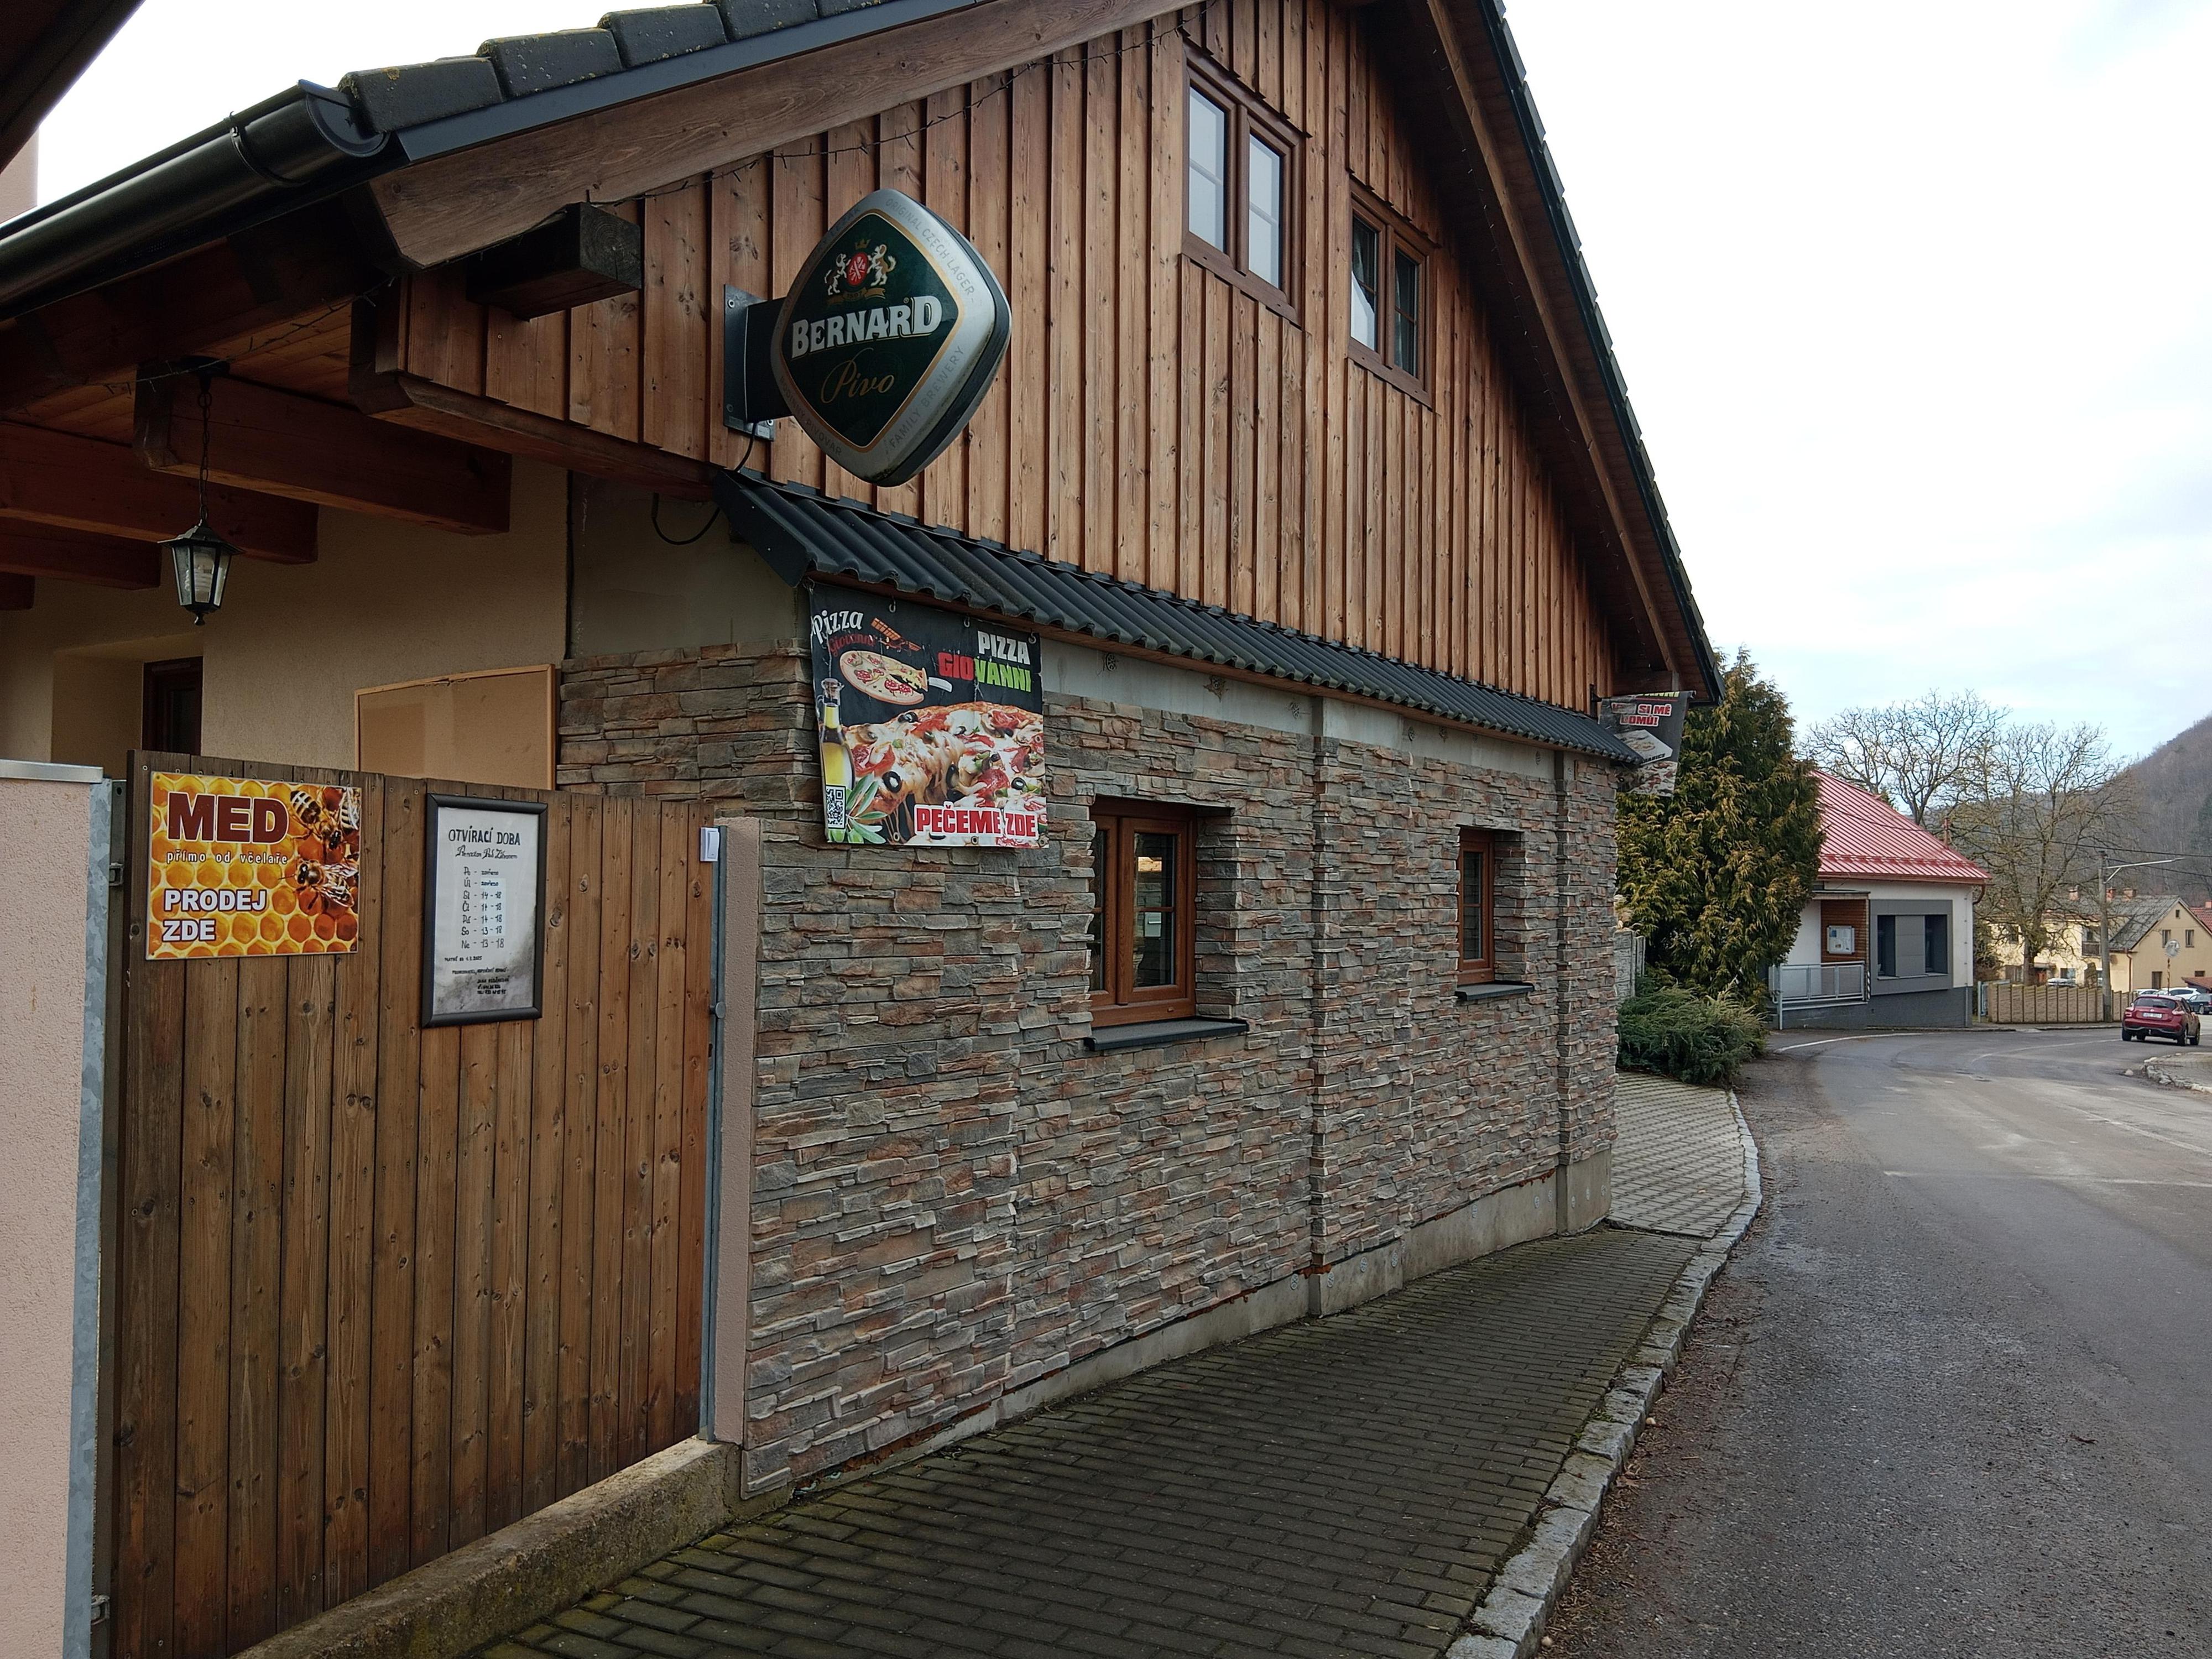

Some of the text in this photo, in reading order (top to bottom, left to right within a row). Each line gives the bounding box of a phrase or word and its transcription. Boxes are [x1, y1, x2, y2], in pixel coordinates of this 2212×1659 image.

[885, 199, 974, 295] ORIGINAL CZECH LAGER
[791, 294, 943, 359] BERNARD
[821, 347, 895, 404] Pivo
[889, 346, 964, 448] FAMILY BREWERY
[806, 418, 842, 455] PIVOVAR
[978, 630, 1030, 665] PIZZA
[937, 652, 1031, 692] GIOVANNI
[1638, 705, 1651, 714] SI
[168, 792, 289, 844] MED
[916, 805, 1036, 837] PEČEME ZDE
[448, 825, 521, 846] OTVÍRACÍ DOBA
[166, 849, 289, 865] přímo od včelaře
[164, 889, 268, 912] PRODEJ
[481, 891, 488, 900] 14
[495, 902, 502, 911] 18
[495, 914, 502, 922] 18
[163, 919, 216, 942] ZDE
[461, 926, 469, 936] So
[481, 927, 488, 935] 13
[495, 925, 502, 934] 18
[461, 940, 470, 949] Ne
[481, 939, 488, 948] 13
[495, 938, 504, 949] 18
